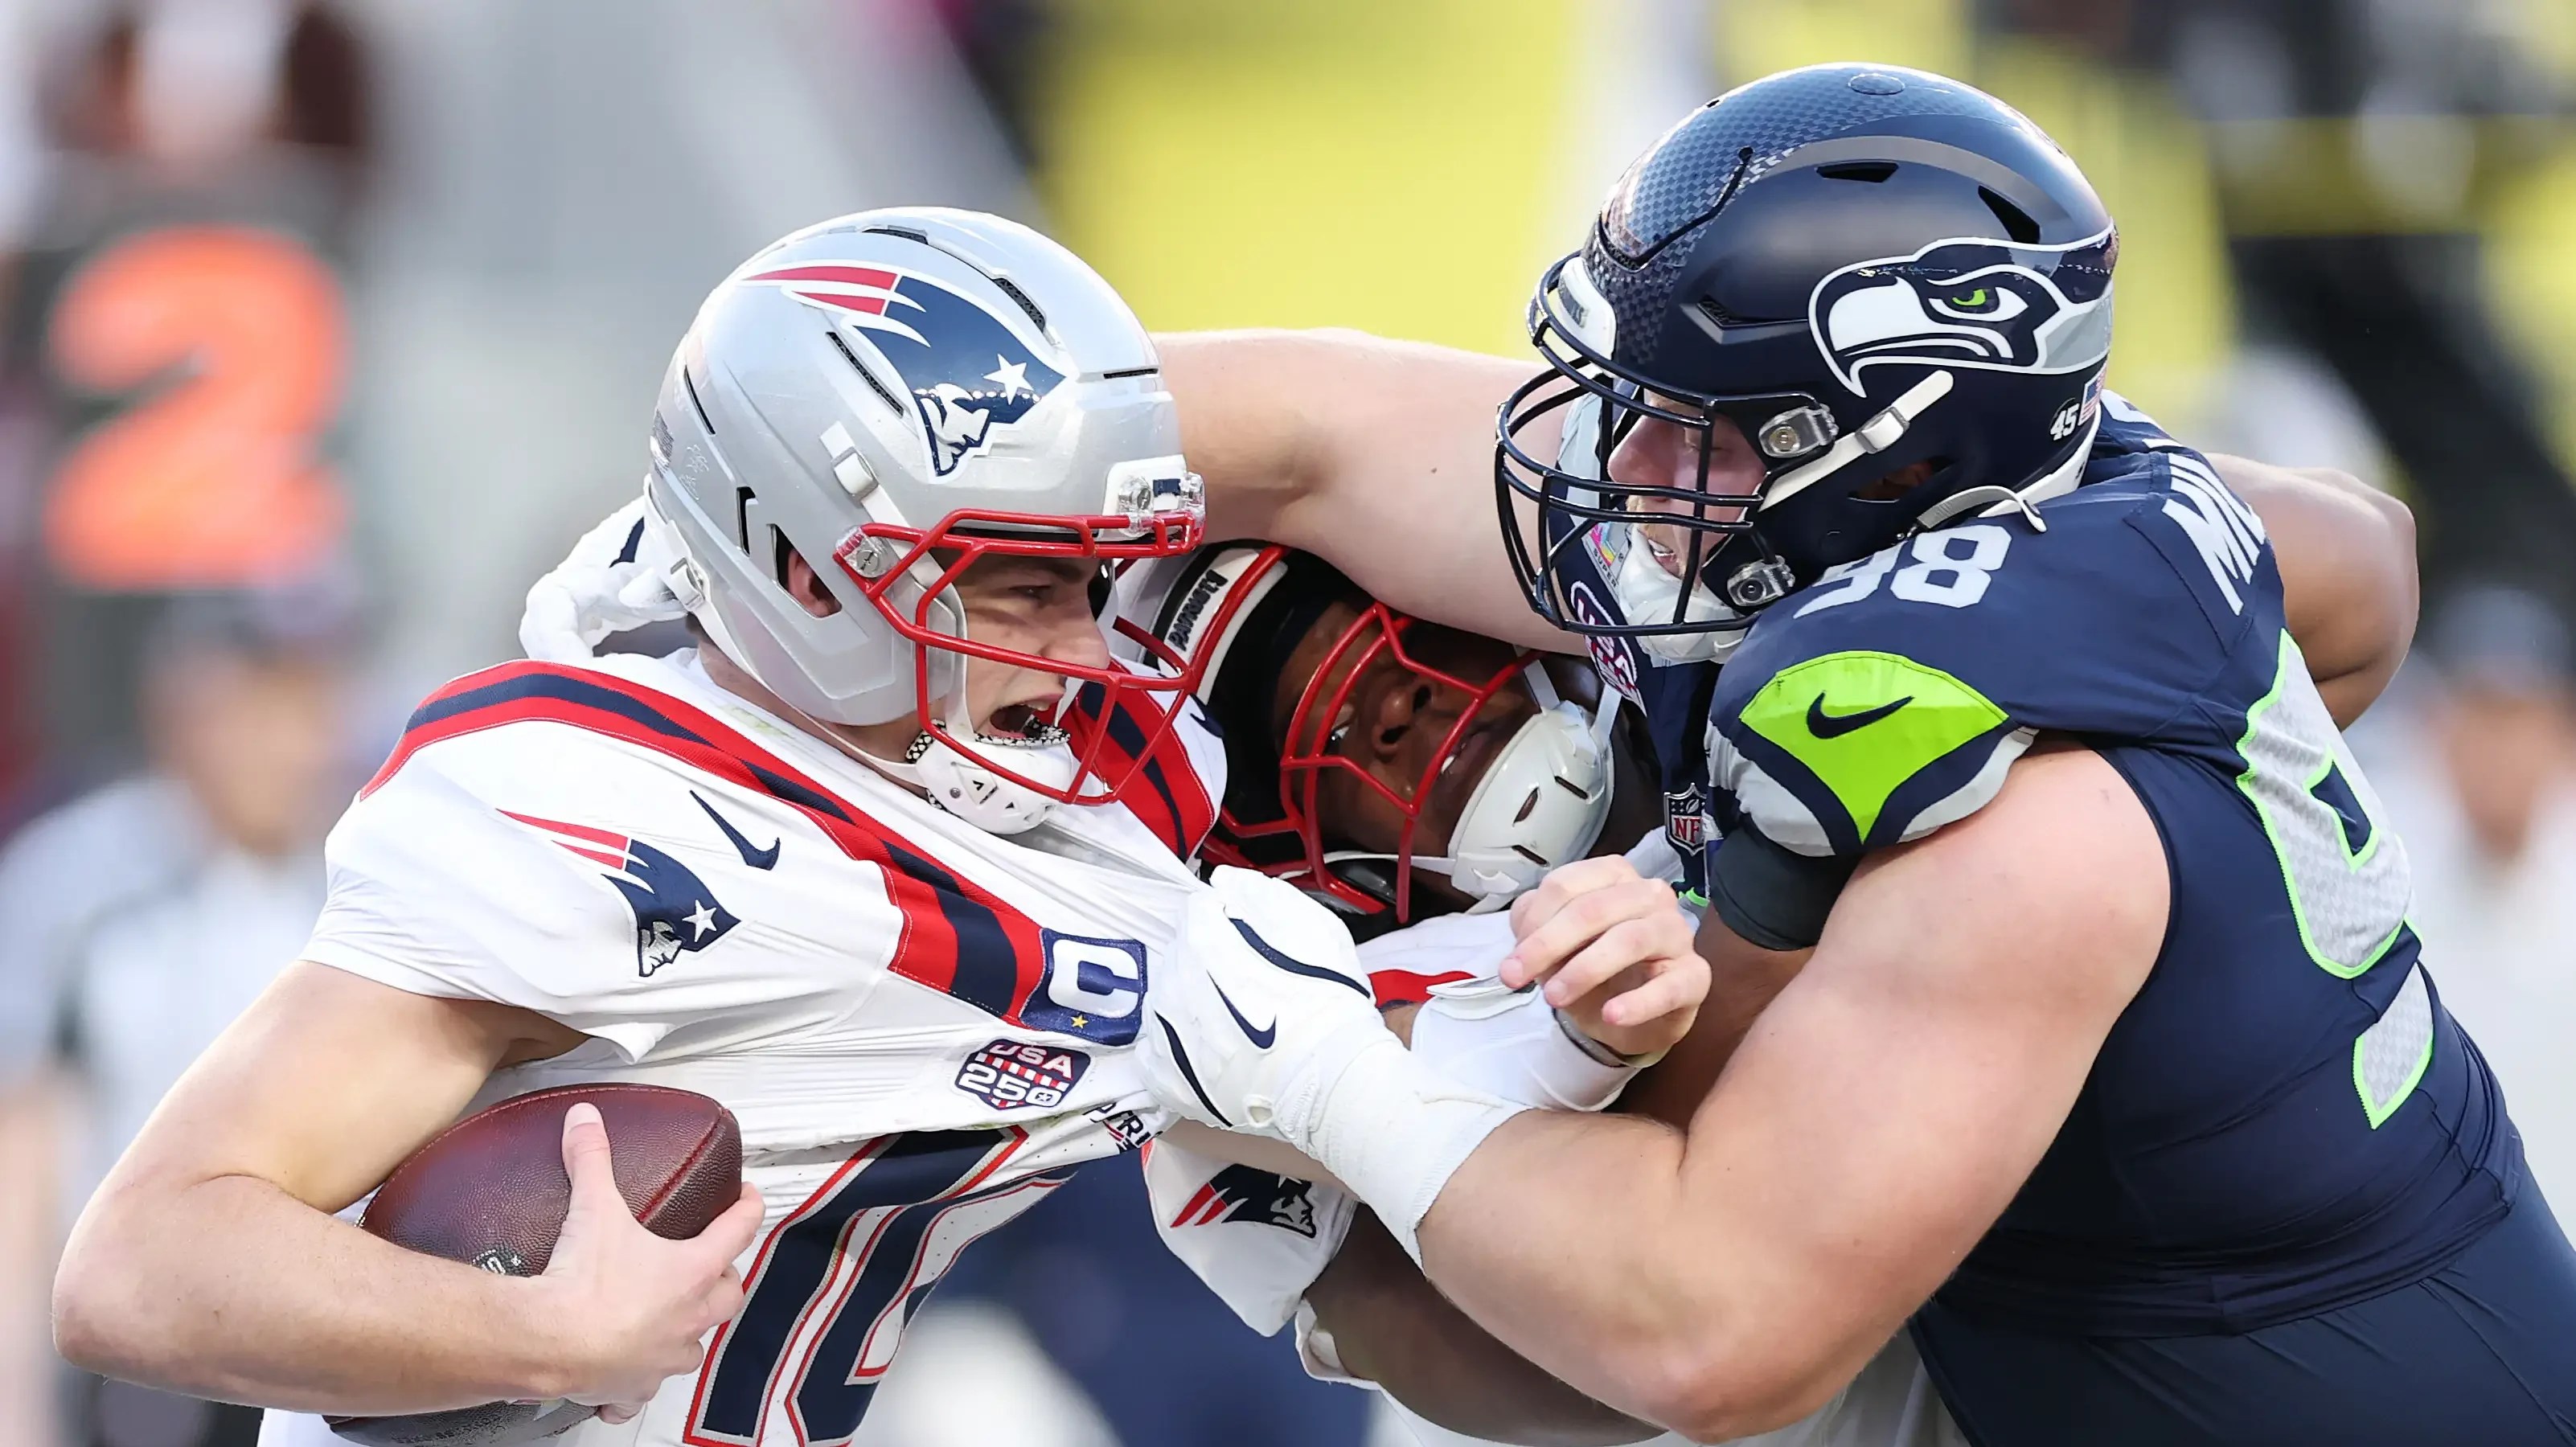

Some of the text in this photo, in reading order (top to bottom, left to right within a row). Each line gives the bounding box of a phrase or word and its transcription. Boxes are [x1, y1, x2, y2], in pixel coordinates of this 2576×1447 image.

[43, 221, 352, 592] 2
[2050, 404, 2080, 441] 45
[1593, 547, 1632, 588] SUPER
[1792, 524, 2012, 620] 98
[1673, 817, 1704, 844] NF
[1052, 938, 1140, 1019] C
[989, 1044, 1073, 1080] USA
[958, 1063, 1063, 1108] 250
